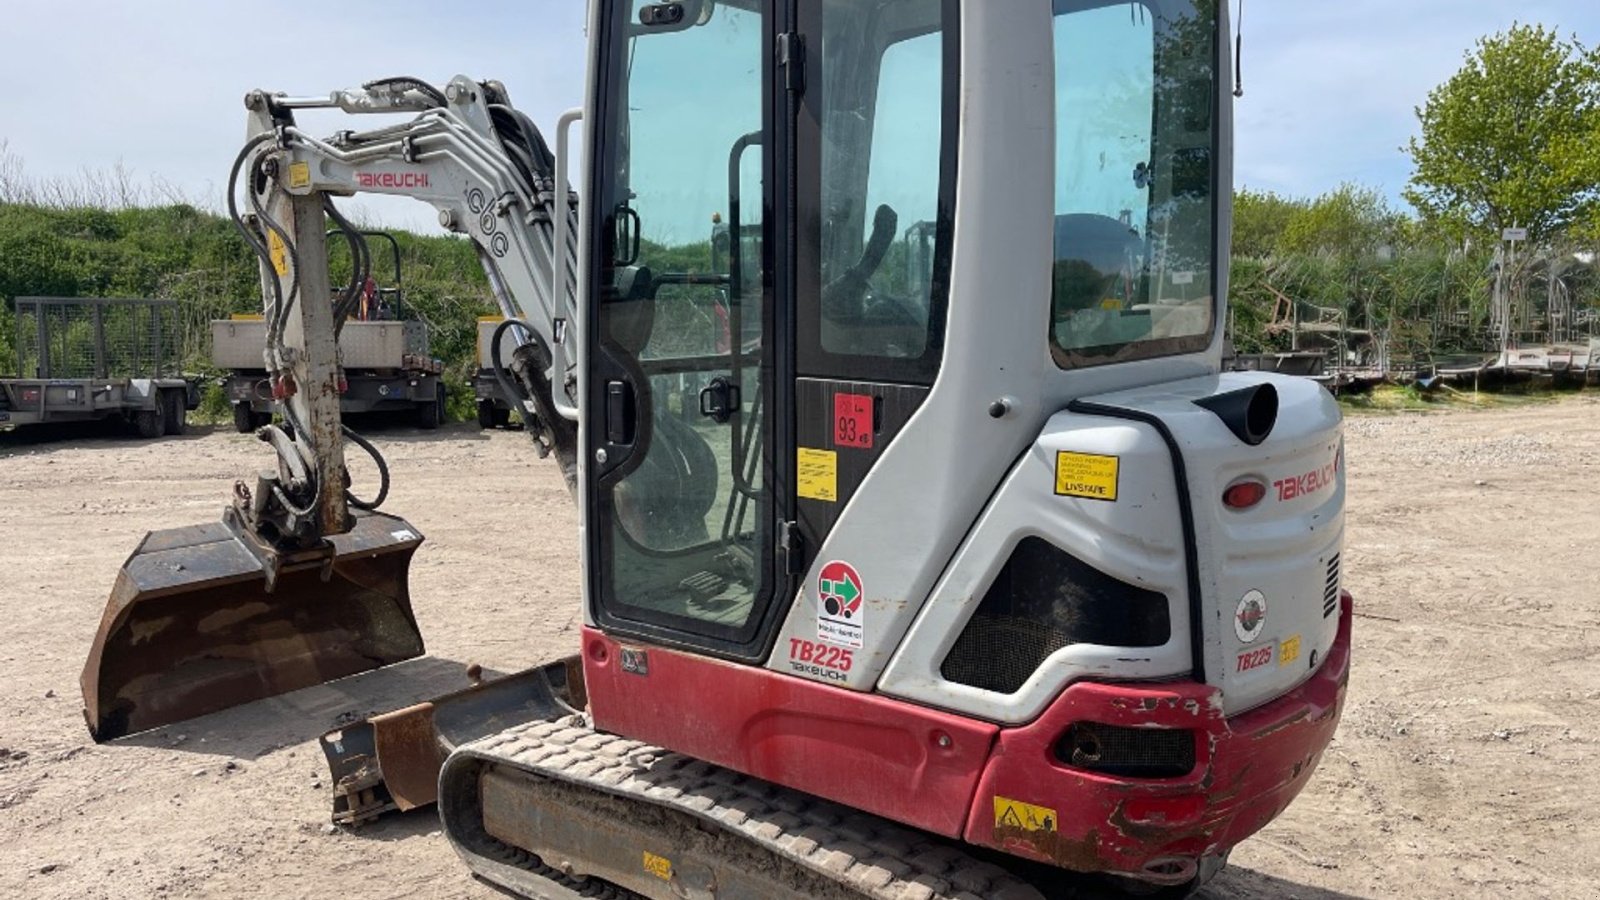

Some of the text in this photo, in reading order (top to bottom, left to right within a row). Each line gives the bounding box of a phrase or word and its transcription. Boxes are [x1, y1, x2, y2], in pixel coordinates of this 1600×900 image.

[355, 172, 430, 188] TAKEUCHI
[838, 416, 857, 442] 93
[789, 637, 854, 672] TB225
[1236, 646, 1273, 673] TB225
[788, 661, 848, 682] TAKEUCHI
